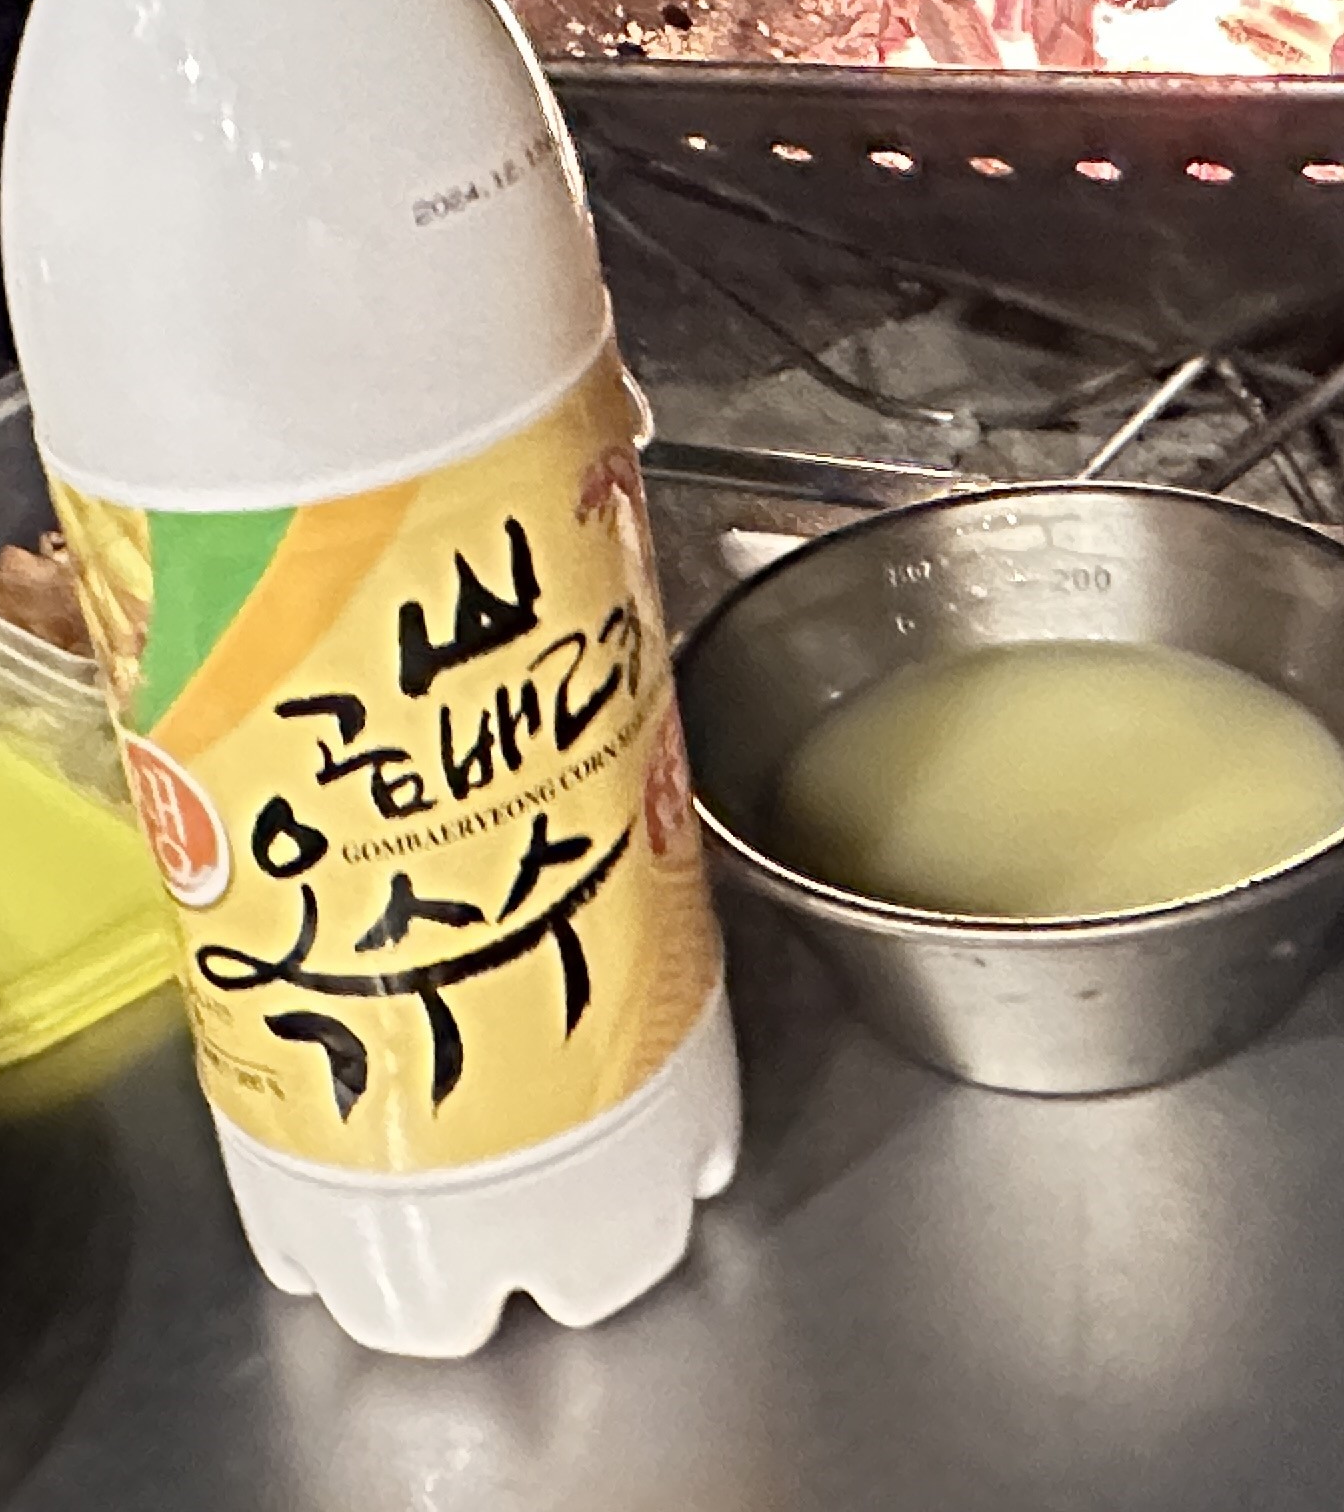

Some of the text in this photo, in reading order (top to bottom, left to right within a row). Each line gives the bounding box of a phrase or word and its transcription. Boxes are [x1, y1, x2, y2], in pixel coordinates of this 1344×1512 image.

[1049, 564, 1112, 594] 200
[342, 777, 556, 865] GOMBAERYEONG
[558, 739, 618, 792] CORN
